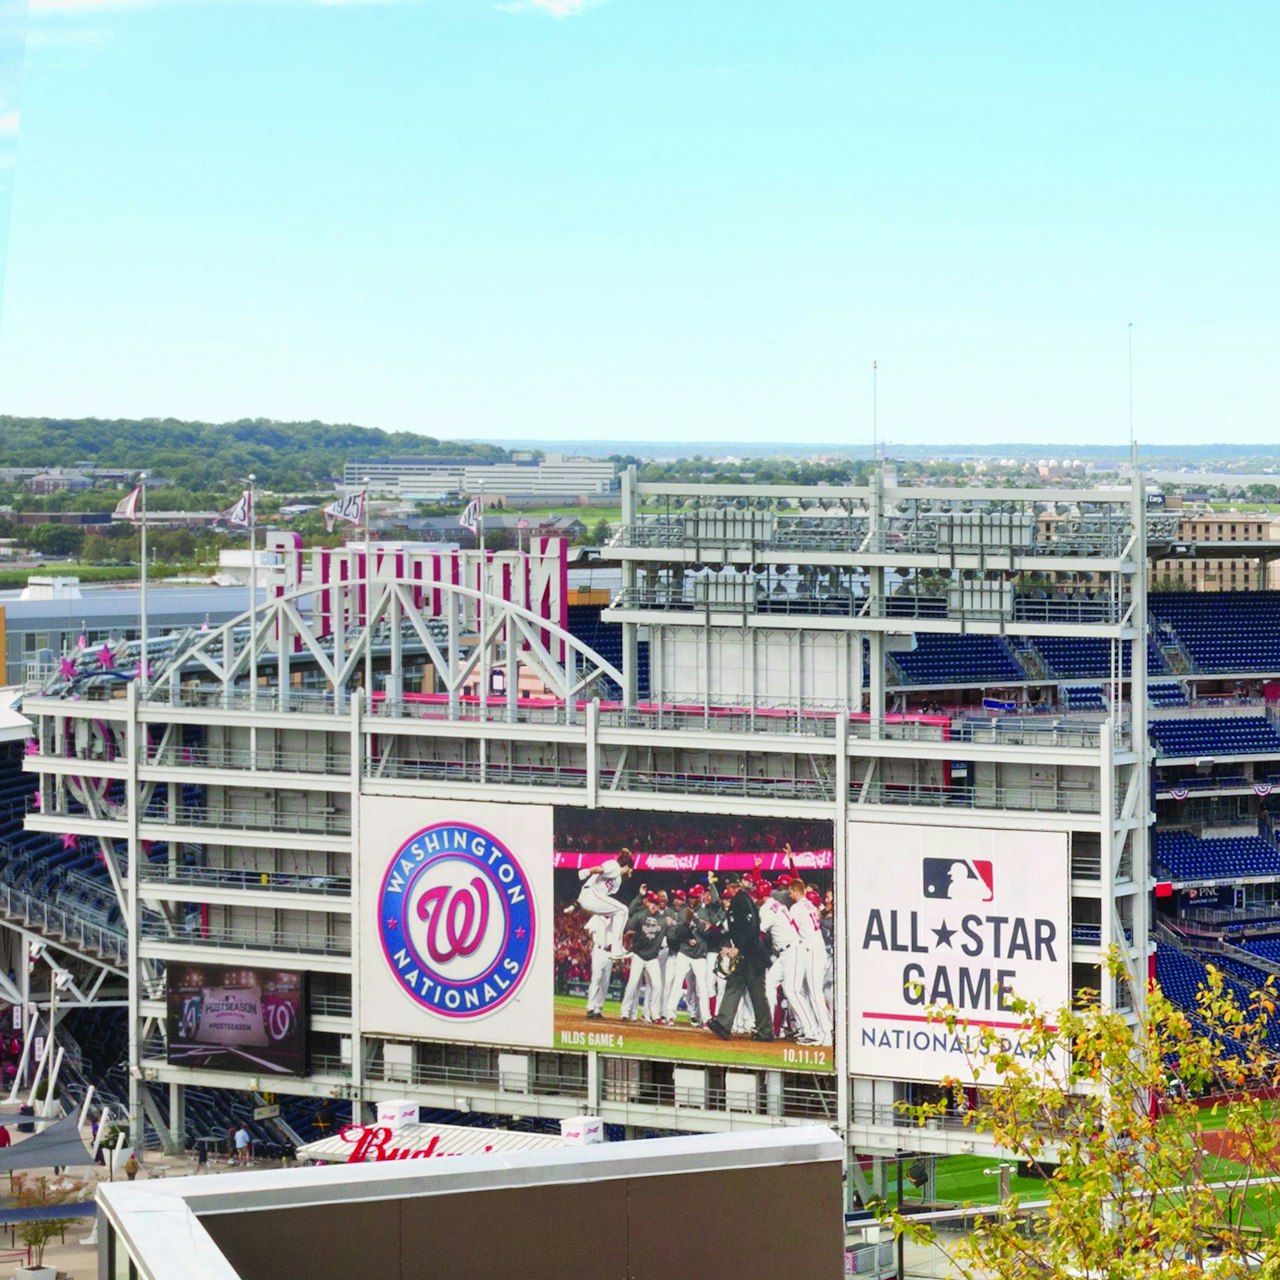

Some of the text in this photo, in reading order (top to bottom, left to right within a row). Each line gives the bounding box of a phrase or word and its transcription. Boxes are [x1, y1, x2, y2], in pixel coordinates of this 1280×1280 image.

[387, 830, 525, 904] WASHINGTON
[1199, 887, 1219, 896] PNC
[416, 877, 490, 964] W
[862, 908, 1058, 962] ALL STAR
[393, 948, 519, 1009] NATIONALS
[902, 963, 1016, 1012] GAME
[205, 1002, 258, 1015] POSTSEASON
[208, 1023, 252, 1031] #POSTSEASON
[561, 1030, 624, 1048] NLDS GAME 4
[861, 1027, 990, 1056] NATIONALS
[783, 1048, 825, 1065] 10.11.12
